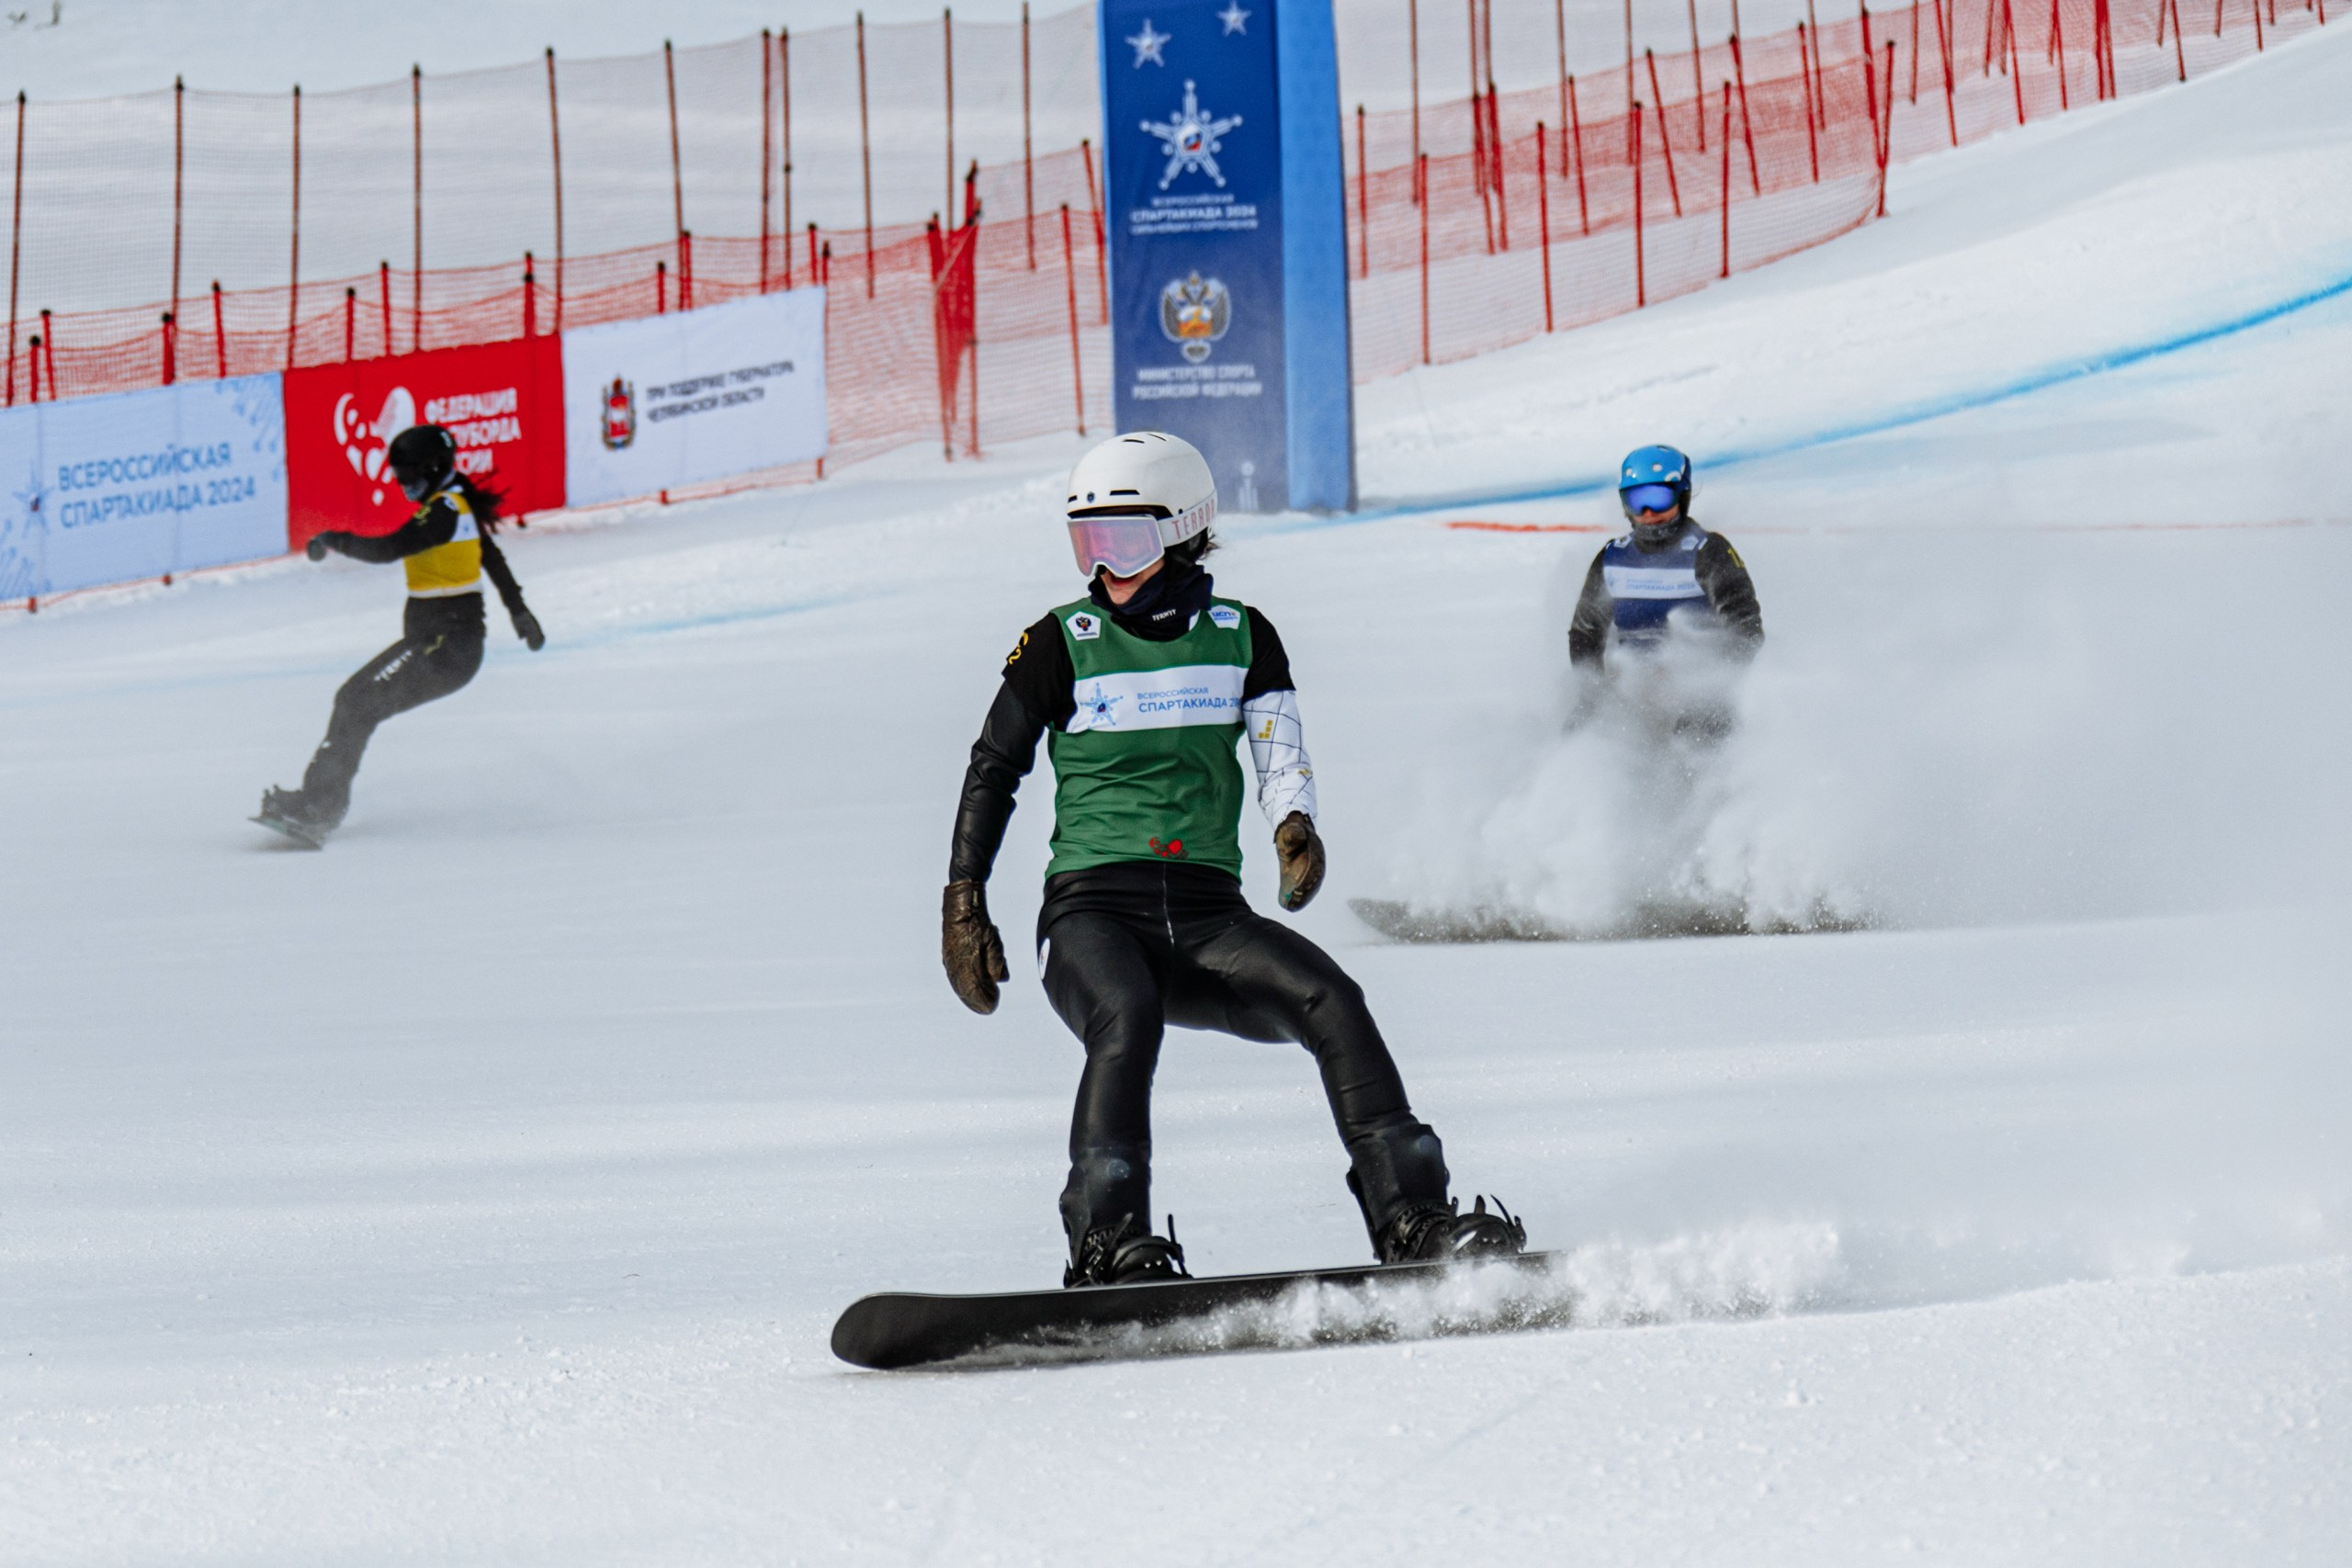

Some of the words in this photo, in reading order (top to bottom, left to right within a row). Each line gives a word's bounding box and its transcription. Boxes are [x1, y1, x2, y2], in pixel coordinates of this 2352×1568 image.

[1131, 209, 1223, 223] СПАРТАКИАДА
[58, 442, 231, 491] ВСЕРОССИЙСКАЯ
[60, 482, 202, 528] СПАРТАКИАДА
[208, 475, 256, 506] 2024
[1137, 687, 1208, 699] ВСЕРОССИЙСКАЯ
[1138, 697, 1227, 713] СПАРТАКИАДА
